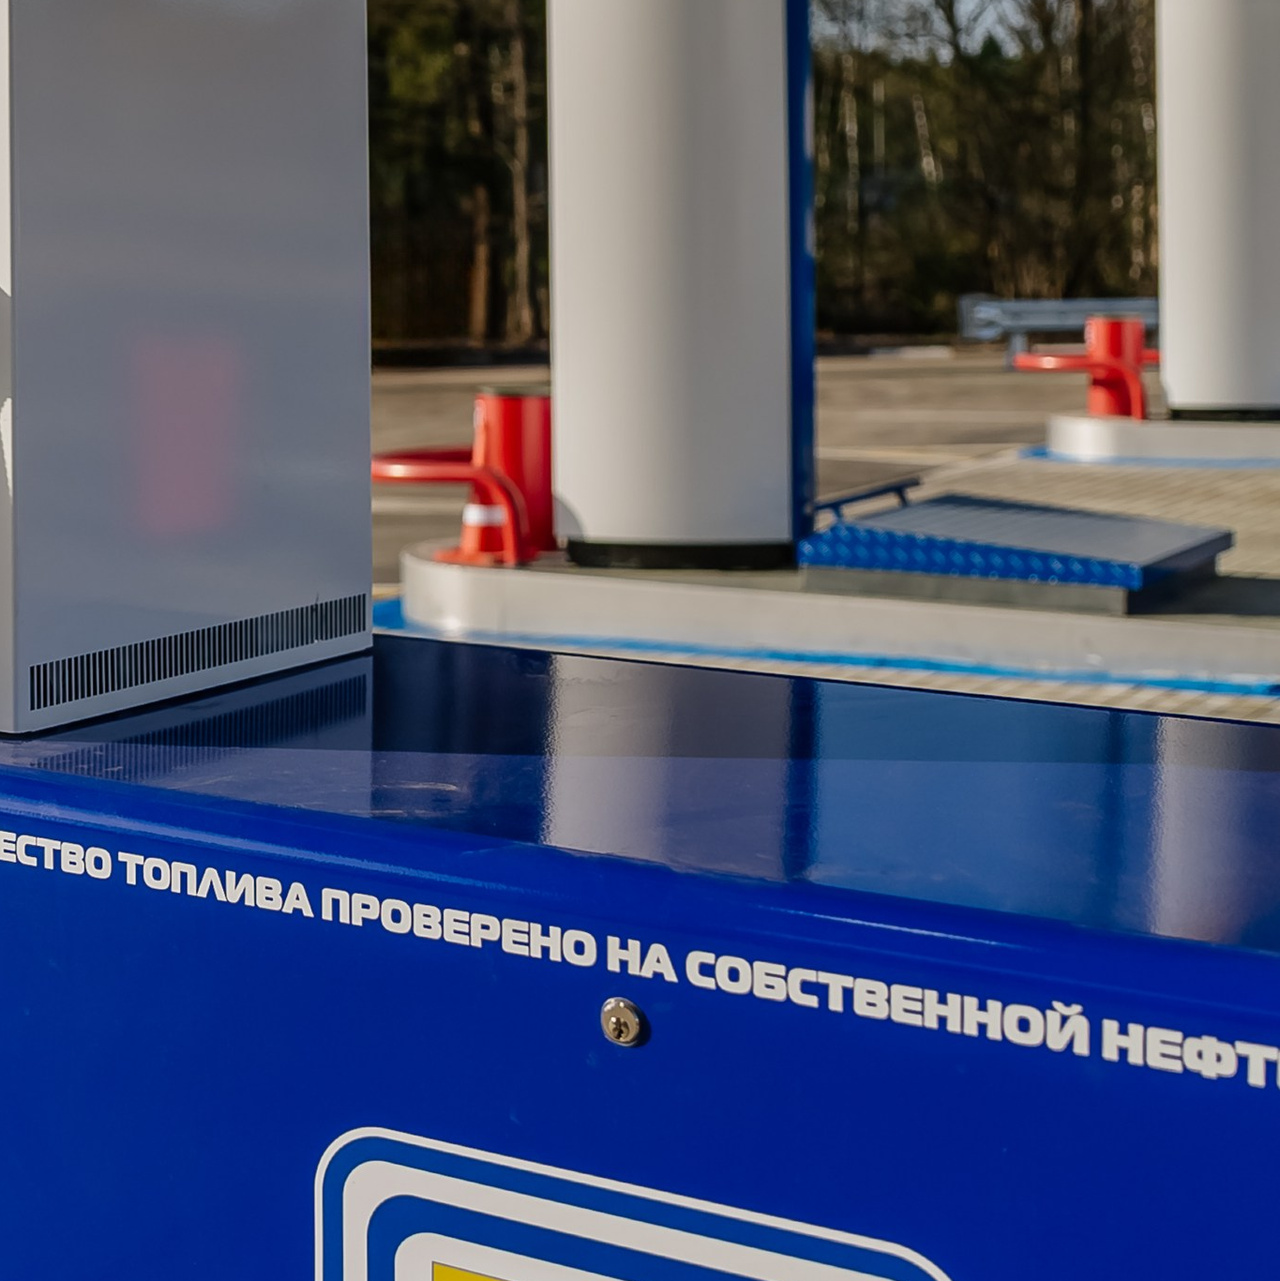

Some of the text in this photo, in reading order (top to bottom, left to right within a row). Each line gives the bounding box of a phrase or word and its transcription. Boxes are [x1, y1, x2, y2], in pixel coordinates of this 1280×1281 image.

[118, 851, 314, 917] ТОПЛИВА
[320, 888, 597, 967] ПРОВЕРЕНО
[606, 934, 677, 983] НА
[685, 950, 1090, 1057] СОБСТВЕННОЙ
[1101, 1018, 1280, 1090] НЕФТ
